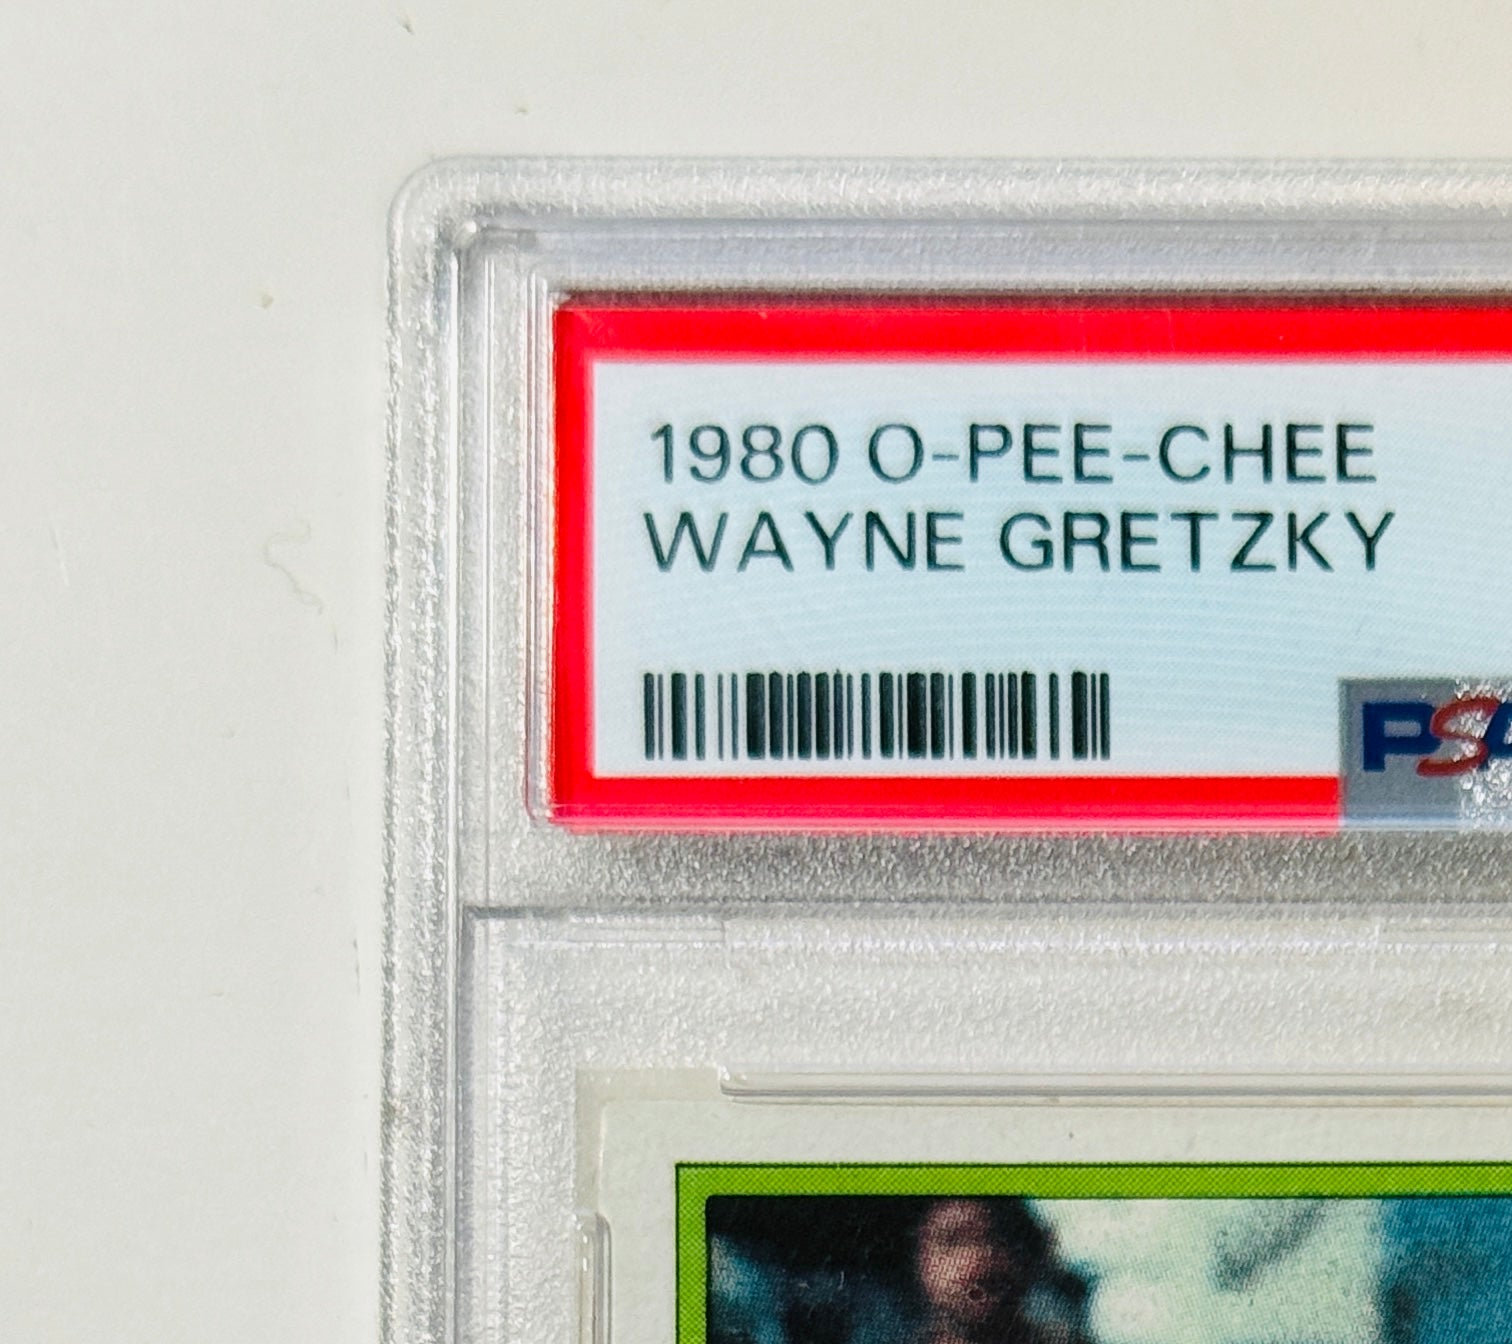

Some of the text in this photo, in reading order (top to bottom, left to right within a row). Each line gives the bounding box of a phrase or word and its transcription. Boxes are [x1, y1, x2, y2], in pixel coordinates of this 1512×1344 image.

[650, 421, 1378, 486] 1980 O-PEE-CHEE
[642, 508, 1397, 574] WAYNE GRETZKY
